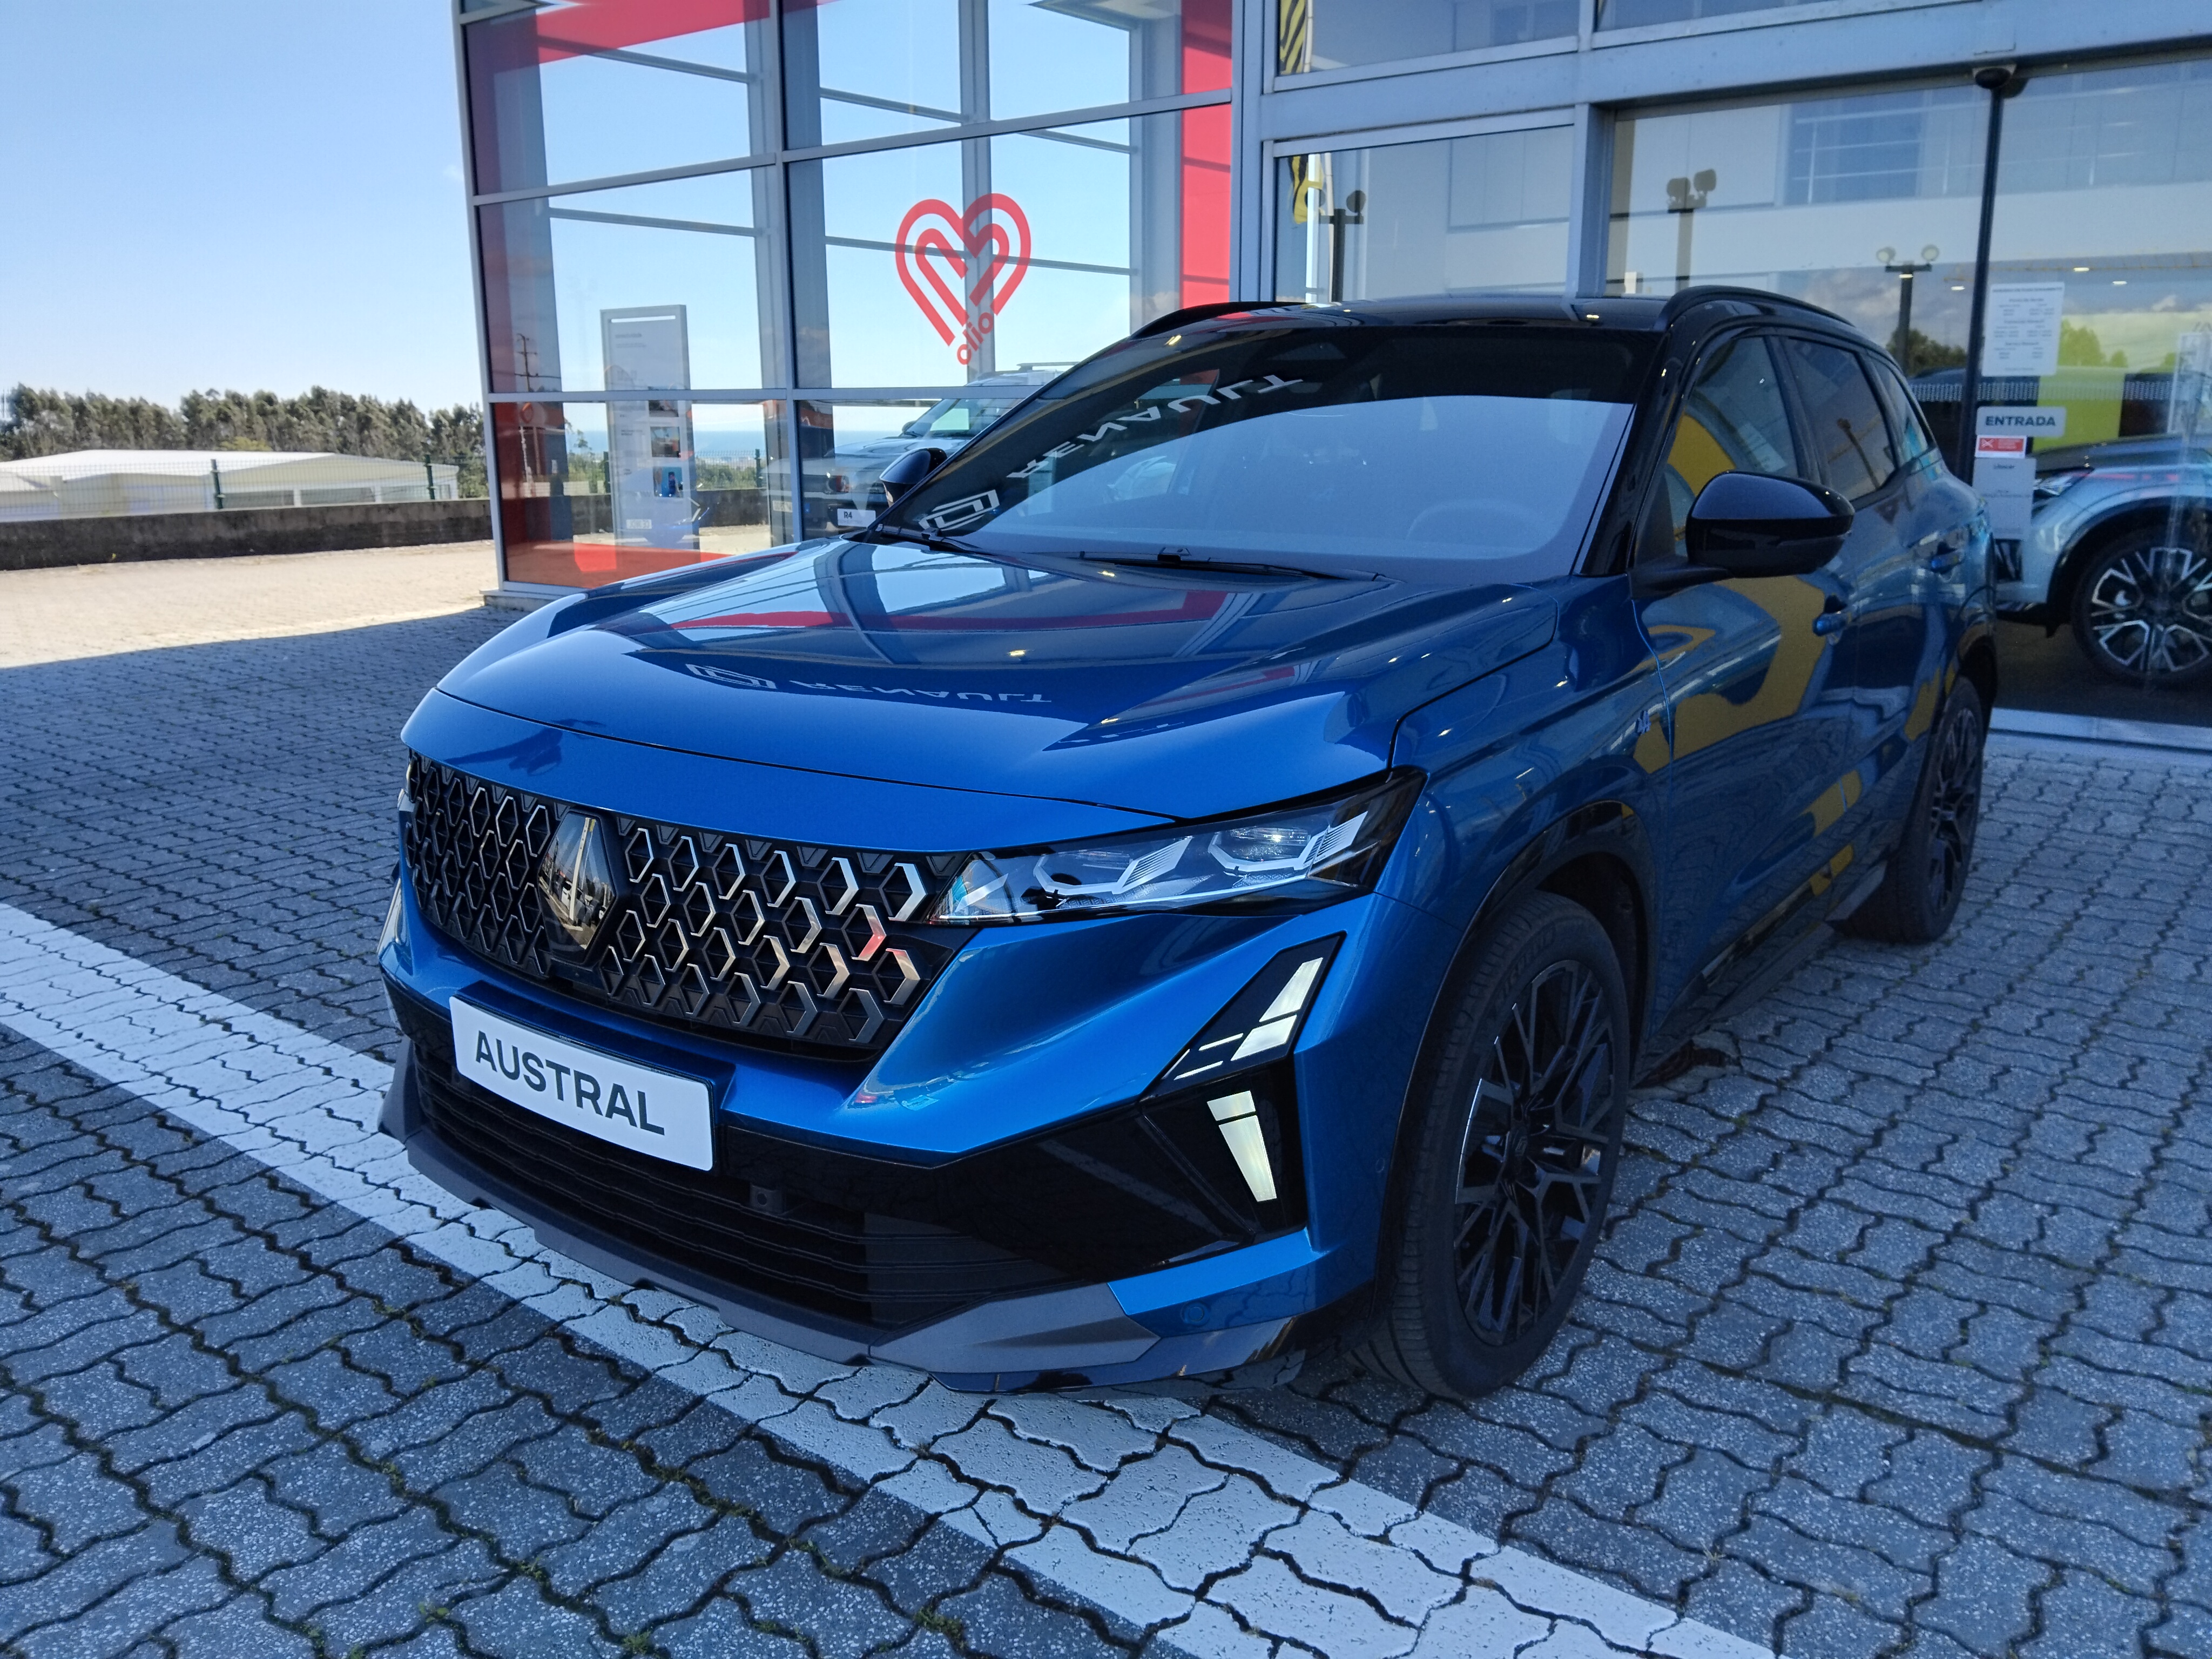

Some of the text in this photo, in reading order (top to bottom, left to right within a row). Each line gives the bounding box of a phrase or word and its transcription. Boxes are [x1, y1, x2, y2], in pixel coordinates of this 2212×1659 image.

[957, 312, 994, 365] clio
[1986, 415, 2055, 426] ENTRADA
[476, 1030, 665, 1136] AUSTRAL
